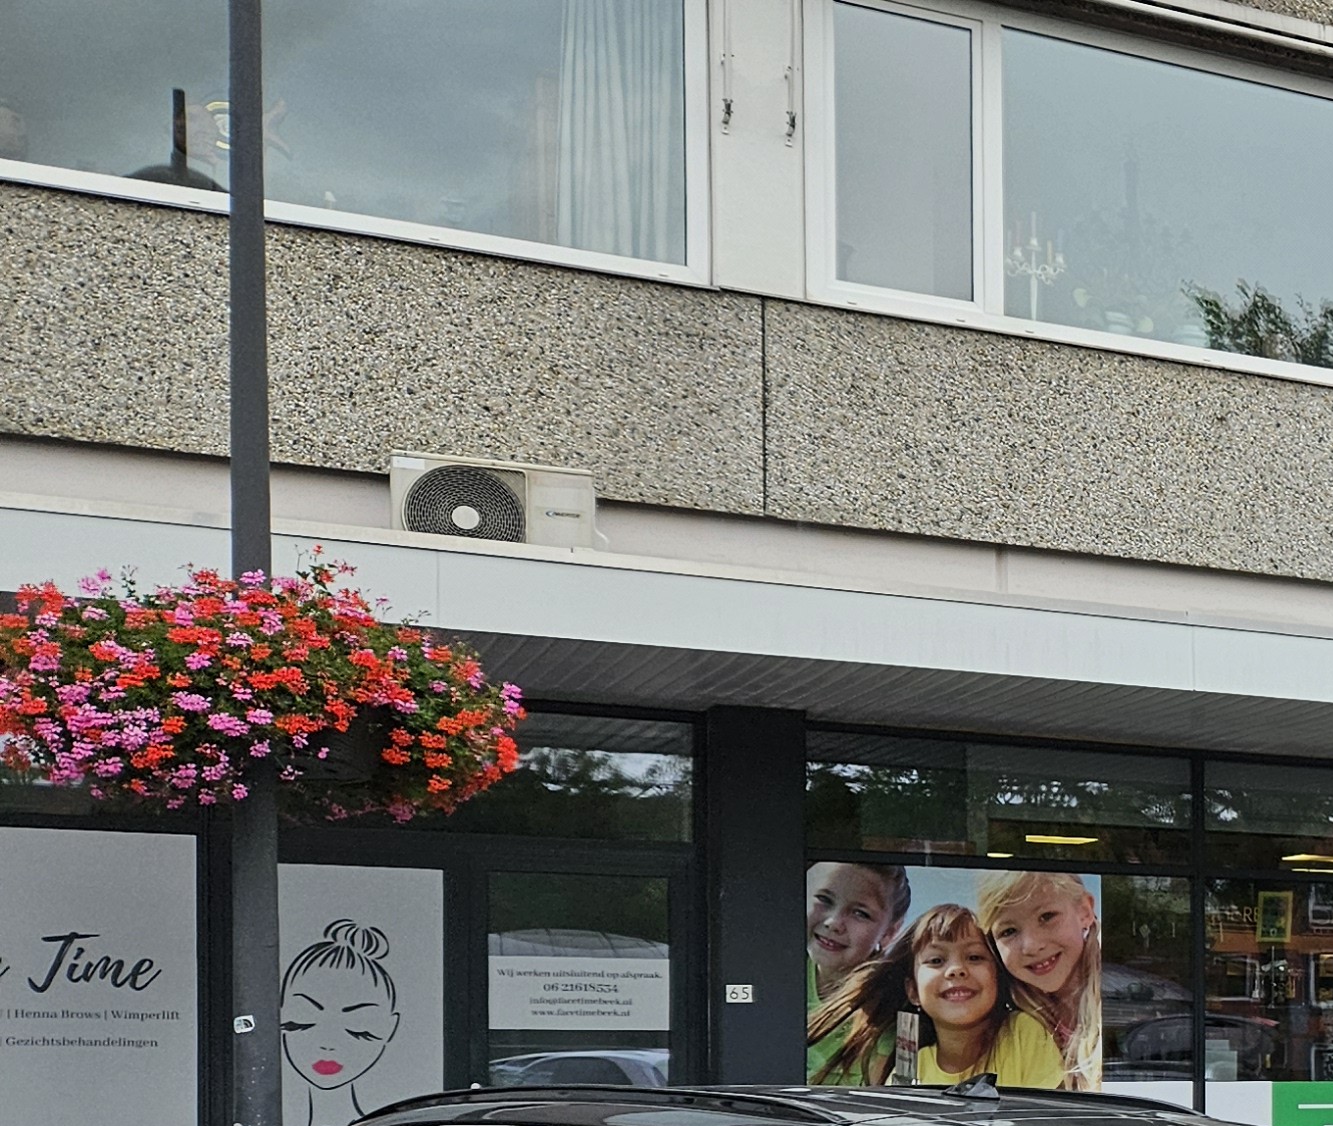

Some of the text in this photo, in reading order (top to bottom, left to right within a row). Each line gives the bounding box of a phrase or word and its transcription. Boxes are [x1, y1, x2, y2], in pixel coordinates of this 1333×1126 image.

[28, 932, 162, 993] Time
[497, 969, 513, 978] Wij
[516, 969, 550, 978] werken
[552, 969, 604, 978] uitsluitend
[606, 972, 619, 980] op
[543, 983, 559, 992] 06
[729, 986, 750, 1000] 65
[14, 1009, 180, 1022] Henna Brows Wimperlift
[5, 1036, 158, 1048] Gezichtsbehandelingen
